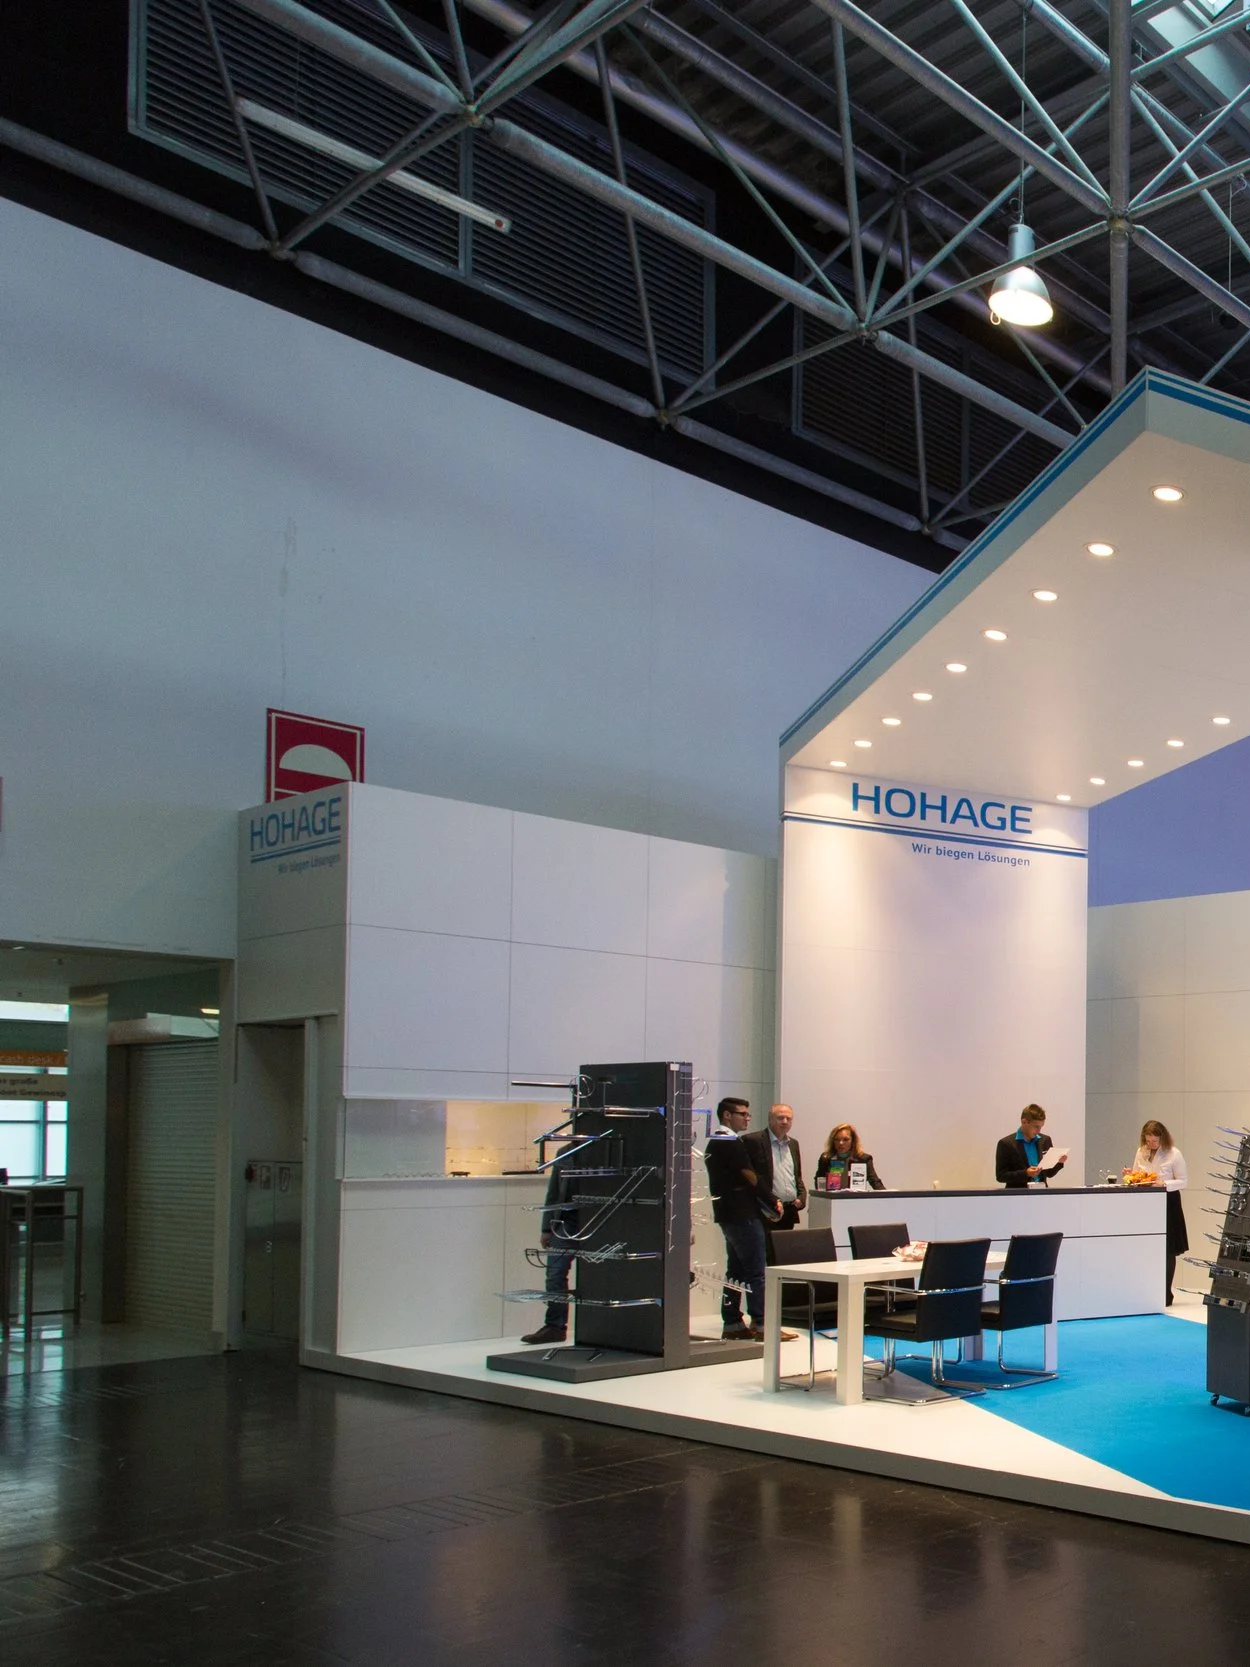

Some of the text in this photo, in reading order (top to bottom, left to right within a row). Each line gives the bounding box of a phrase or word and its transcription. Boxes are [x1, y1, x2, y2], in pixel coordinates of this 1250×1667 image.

[250, 796, 342, 851] HOHAGE
[852, 782, 1033, 834] HOHAGE
[911, 842, 1031, 866] Wir biegen Lösungen
